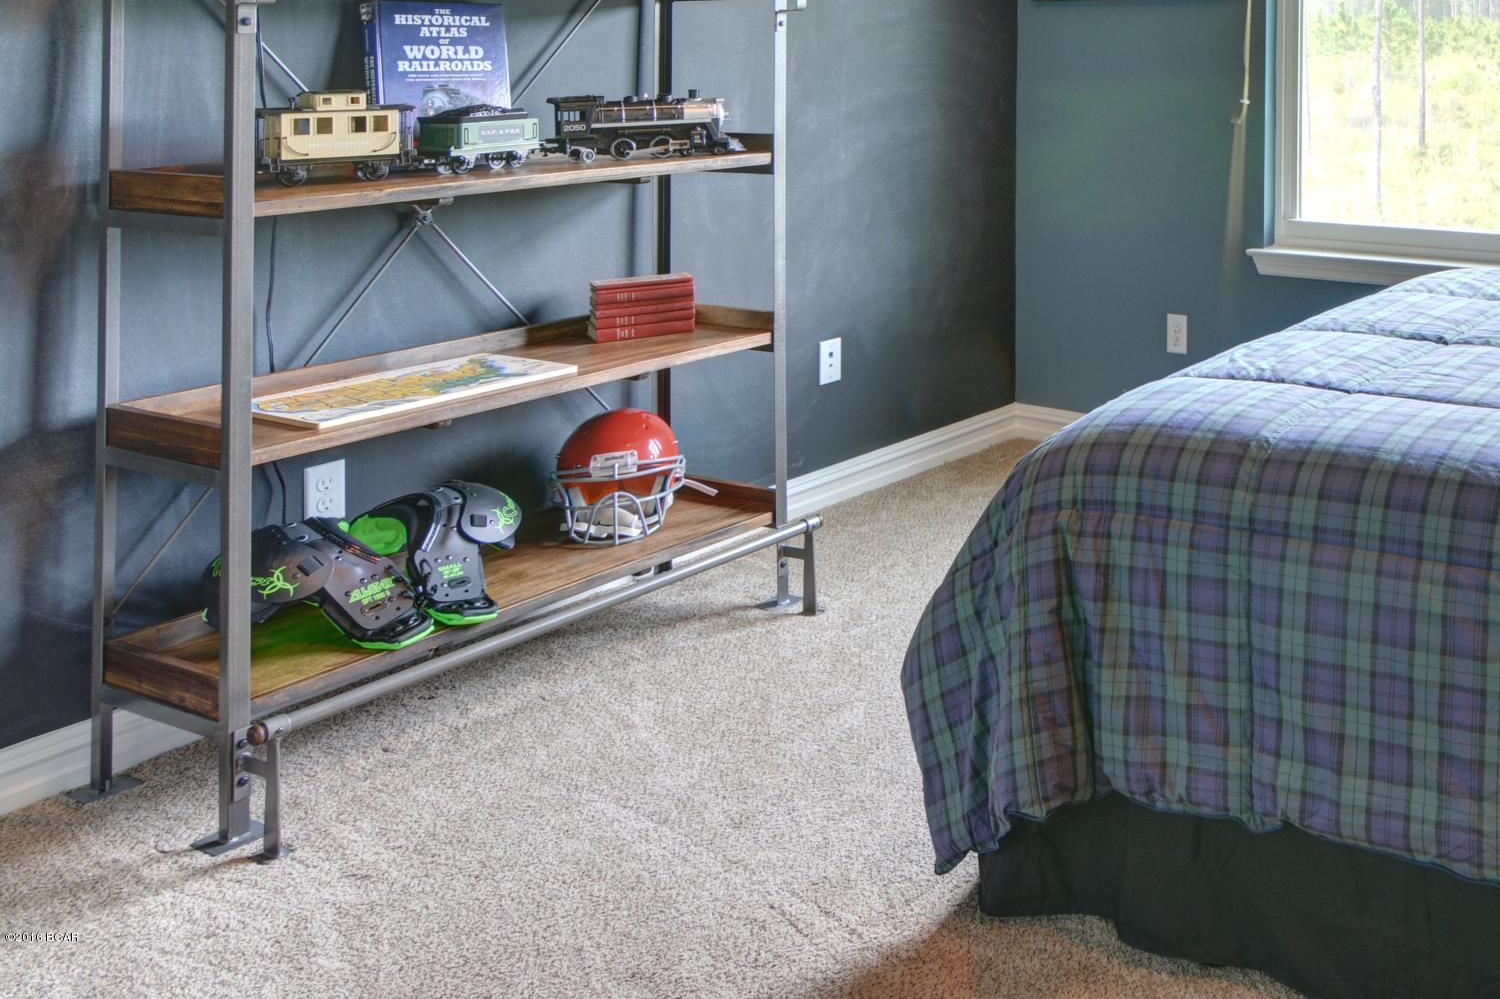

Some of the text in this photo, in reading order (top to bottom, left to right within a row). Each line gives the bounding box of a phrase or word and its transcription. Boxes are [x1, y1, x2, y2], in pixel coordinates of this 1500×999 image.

[394, 14, 490, 26] HISTORICAL
[419, 26, 468, 37] ATLAS
[403, 45, 484, 60] WORLD
[397, 60, 493, 72] RAILROADS
[562, 124, 587, 132] 2050
